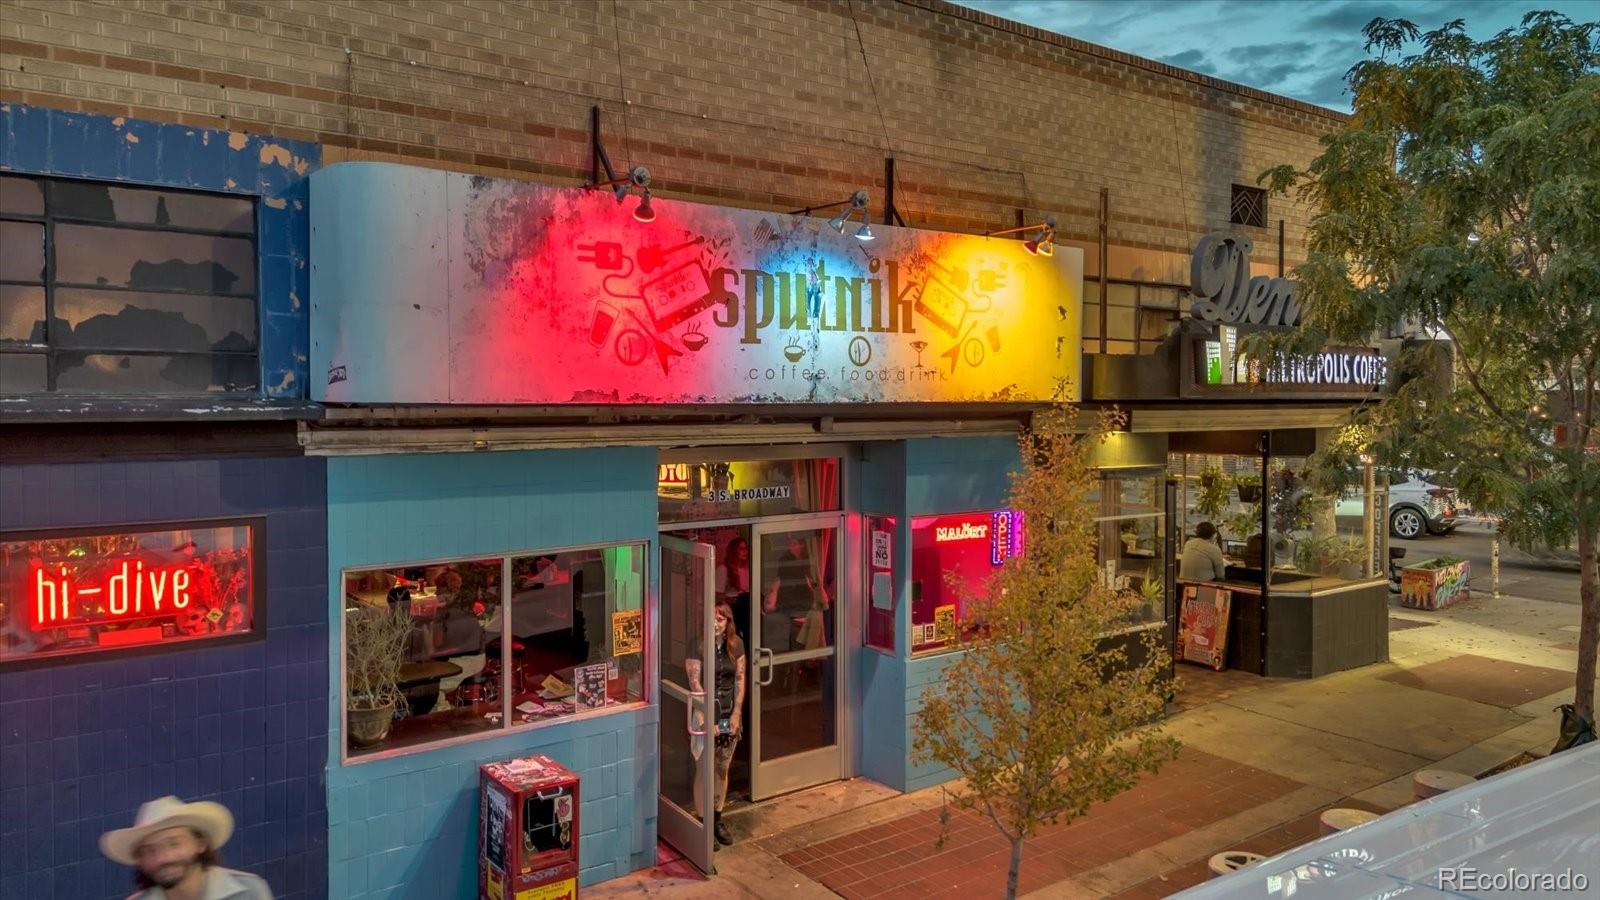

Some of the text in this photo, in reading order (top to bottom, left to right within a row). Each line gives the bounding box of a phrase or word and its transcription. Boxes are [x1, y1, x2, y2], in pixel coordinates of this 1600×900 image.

[712, 258, 916, 344] sputnik
[708, 486, 789, 501] 3 S. BROADWAY
[936, 523, 988, 541] MALÖRT
[37, 560, 189, 624] hi-dive
